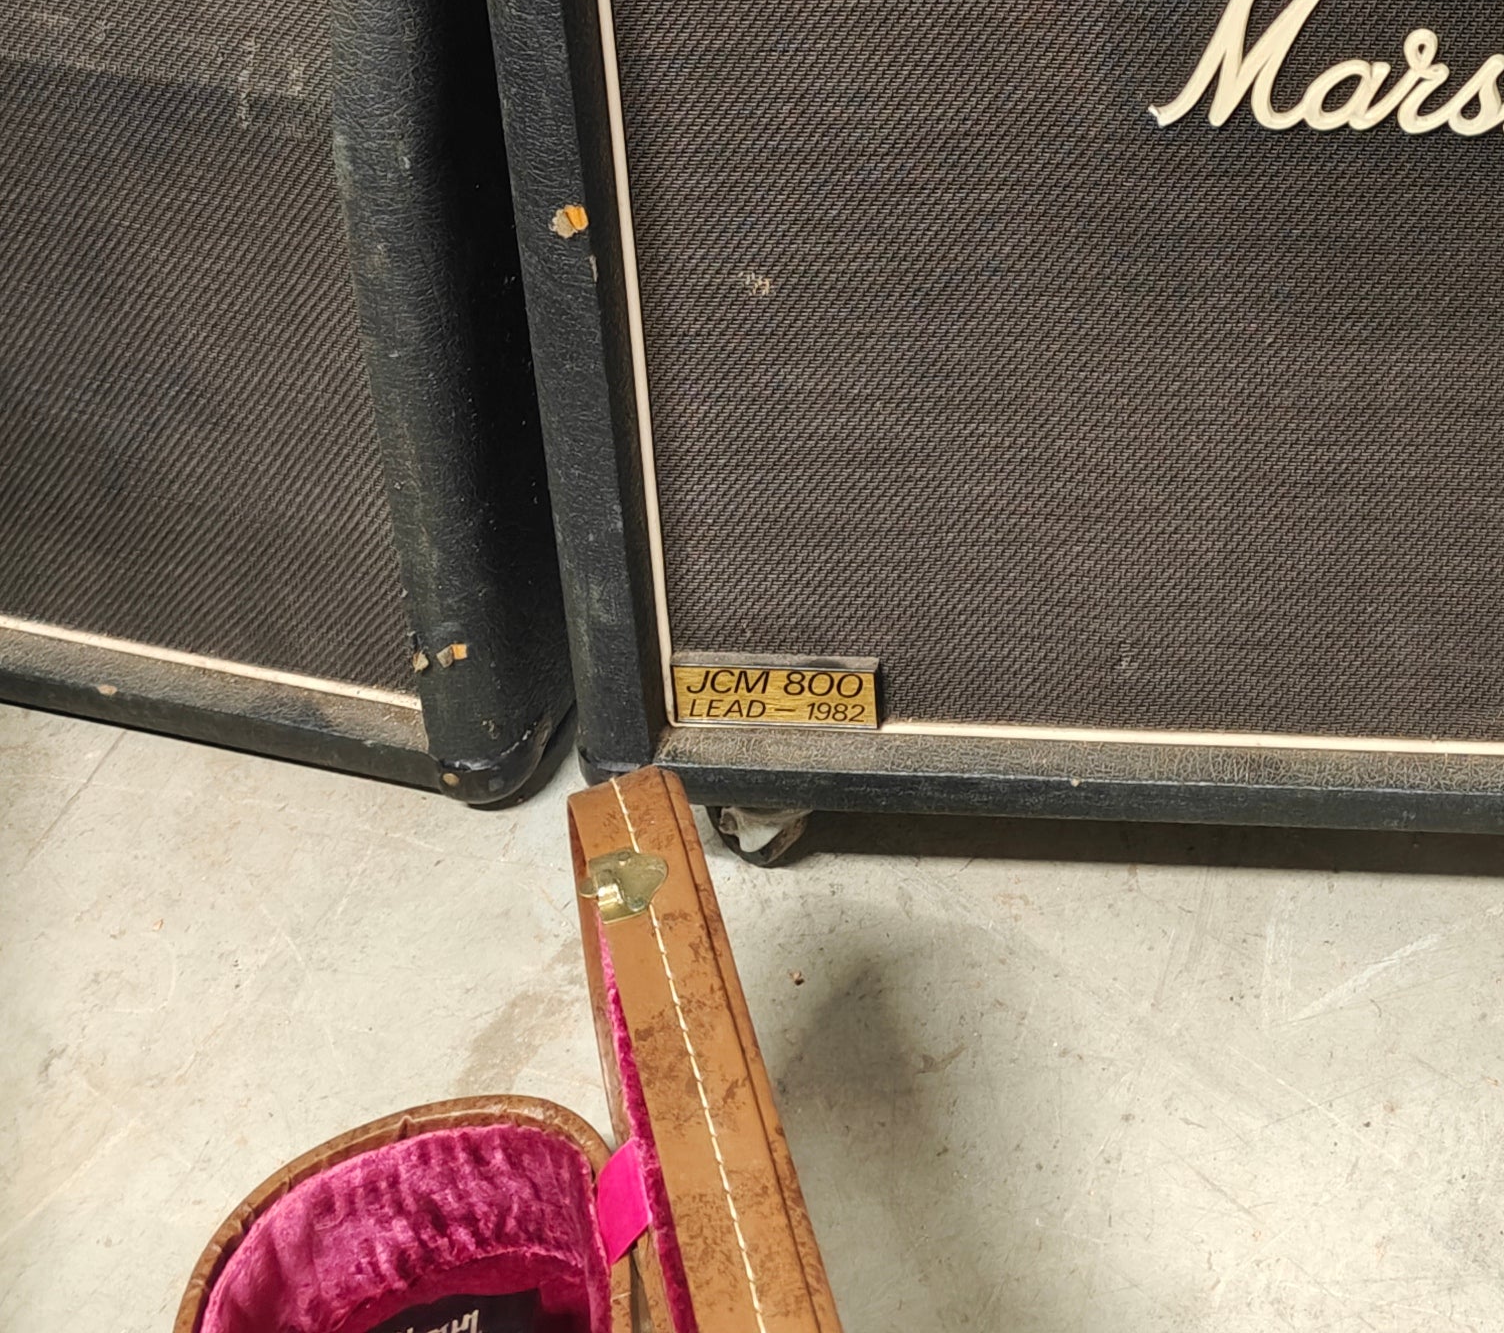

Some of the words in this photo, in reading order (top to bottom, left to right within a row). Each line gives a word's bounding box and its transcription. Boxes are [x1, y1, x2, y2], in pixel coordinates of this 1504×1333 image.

[686, 670, 770, 694] JCM
[783, 671, 864, 698] 800
[689, 699, 767, 718] LEAD
[806, 702, 865, 722] 1982
